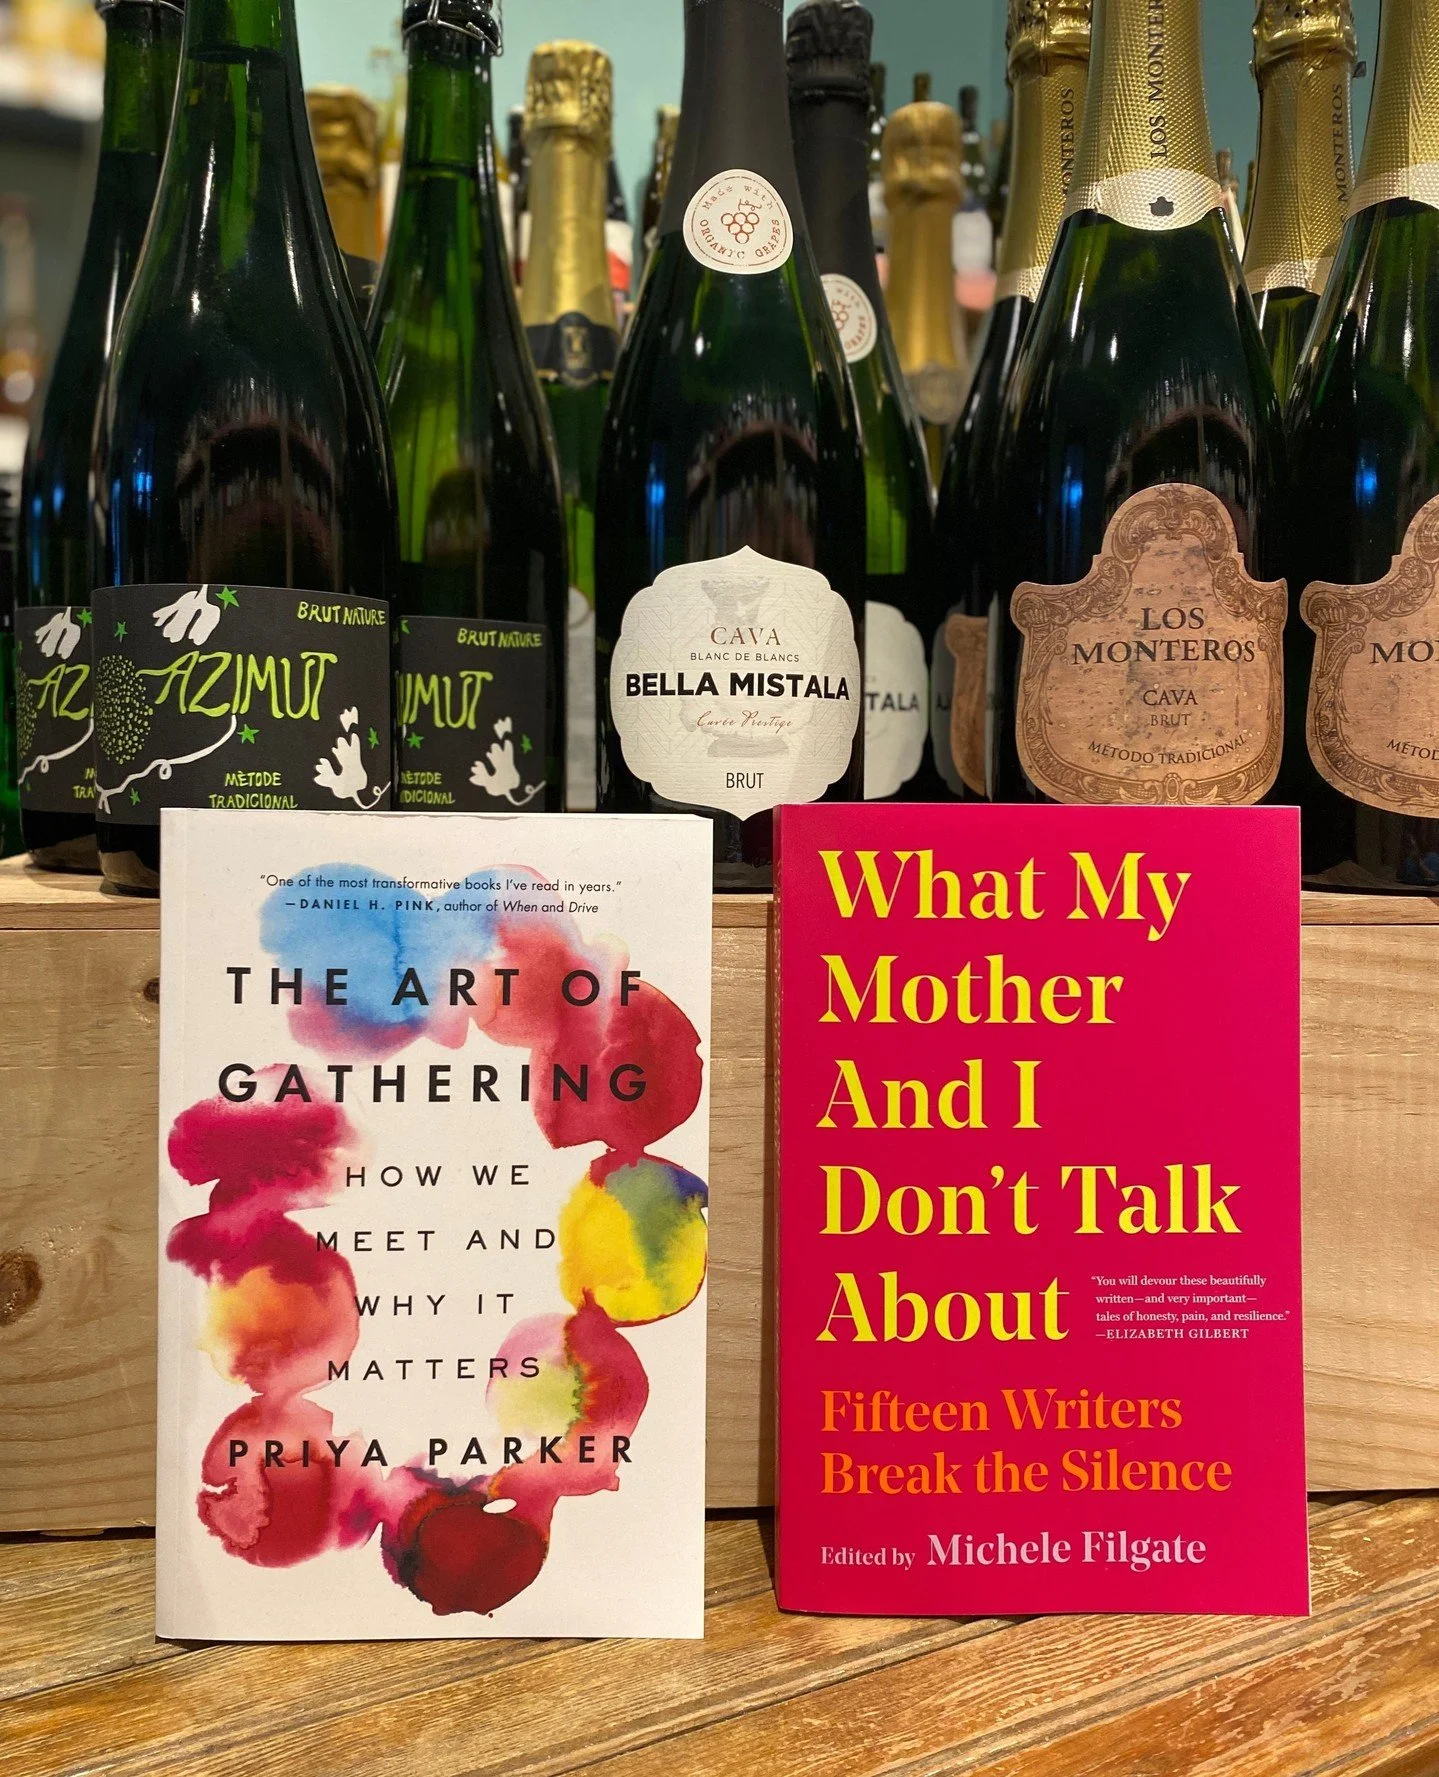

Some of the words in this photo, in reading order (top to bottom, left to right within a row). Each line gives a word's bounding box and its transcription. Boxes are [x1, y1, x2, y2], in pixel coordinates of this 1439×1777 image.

[1061, 87, 1074, 195] ONTEROS
[1150, 115, 1168, 159] LOS
[703, 186, 733, 210] Made
[744, 185, 773, 209] with
[700, 219, 745, 259] ORGANIC
[755, 219, 781, 258] GRAPES
[298, 601, 341, 626] BRUT
[341, 605, 386, 626] NATURE
[1141, 607, 1204, 631] LOS
[457, 628, 497, 647] BRUT
[498, 631, 543, 648] NATURE
[710, 626, 782, 647] CAVA
[690, 652, 730, 662] BLANC
[735, 652, 750, 662] DE
[755, 653, 800, 663] BLANCS
[1072, 639, 1256, 665] MONTEROS
[137, 651, 338, 721] AZIMUT
[626, 672, 719, 697] BELLA
[729, 672, 850, 701] MISTALA
[1142, 689, 1199, 707] CAVA
[865, 692, 920, 711] TALA
[740, 709, 794, 734] Prestige
[1150, 714, 1190, 727] BRUT
[1087, 740, 1155, 765] MÉTODO
[1159, 735, 1247, 764] TRADICIONAL
[726, 772, 764, 789] BRUT
[208, 793, 298, 810] TRADICIONAL
[260, 875, 297, 888] “One
[298, 875, 313, 888] of
[315, 876, 335, 888] the
[338, 878, 368, 889] most
[372, 877, 461, 890] transformative
[465, 877, 502, 891] books
[506, 879, 527, 891] I’ve
[531, 879, 560, 892] read
[564, 880, 575, 892] in
[818, 849, 1046, 920] What
[1066, 852, 1192, 942] My
[369, 900, 386, 910] H.
[395, 900, 440, 913] PINK,
[443, 901, 483, 913] author
[485, 900, 500, 913] of
[503, 901, 538, 913] When
[541, 902, 564, 913] and
[568, 902, 599, 914] Drive
[226, 967, 348, 1006] THE
[391, 968, 520, 1006] ART
[561, 970, 641, 1007] OF
[817, 954, 1125, 1025] Mother
[218, 1063, 648, 1103] GATHERING
[816, 1058, 989, 1130] And
[1012, 1060, 1043, 1129] I
[346, 1165, 442, 1187] HOW
[472, 1164, 529, 1186] WE
[819, 1165, 1040, 1236] Don’t
[1061, 1163, 1243, 1235] Talk
[316, 1230, 436, 1253] MEET
[466, 1228, 556, 1250] AND
[1119, 1275, 1138, 1285] will
[1140, 1275, 1177, 1286] devour
[1180, 1275, 1208, 1285] these
[1210, 1275, 1266, 1288] beautifully
[355, 1295, 446, 1317] WHY
[478, 1293, 514, 1315] IT
[816, 1271, 1070, 1343] About
[1167, 1295, 1190, 1306] very
[1096, 1311, 1121, 1322] tales
[1123, 1311, 1136, 1322] of
[1136, 1311, 1179, 1324] honesty,
[1182, 1311, 1208, 1324] pain,
[1211, 1310, 1231, 1321] and
[1189, 1328, 1249, 1339] GILBERT
[327, 1357, 540, 1381] MATTERS
[820, 1388, 990, 1433] Fifteen
[1001, 1387, 1183, 1430] Writers
[229, 1439, 388, 1467] PRIYA
[429, 1435, 632, 1465] PARKER
[820, 1451, 962, 1496] Break
[973, 1450, 1050, 1493] the
[1062, 1449, 1233, 1493] Silence
[820, 1546, 887, 1566] Edited
[892, 1547, 916, 1570] by
[927, 1531, 1072, 1566] Michele
[1081, 1530, 1207, 1573] Filgate
